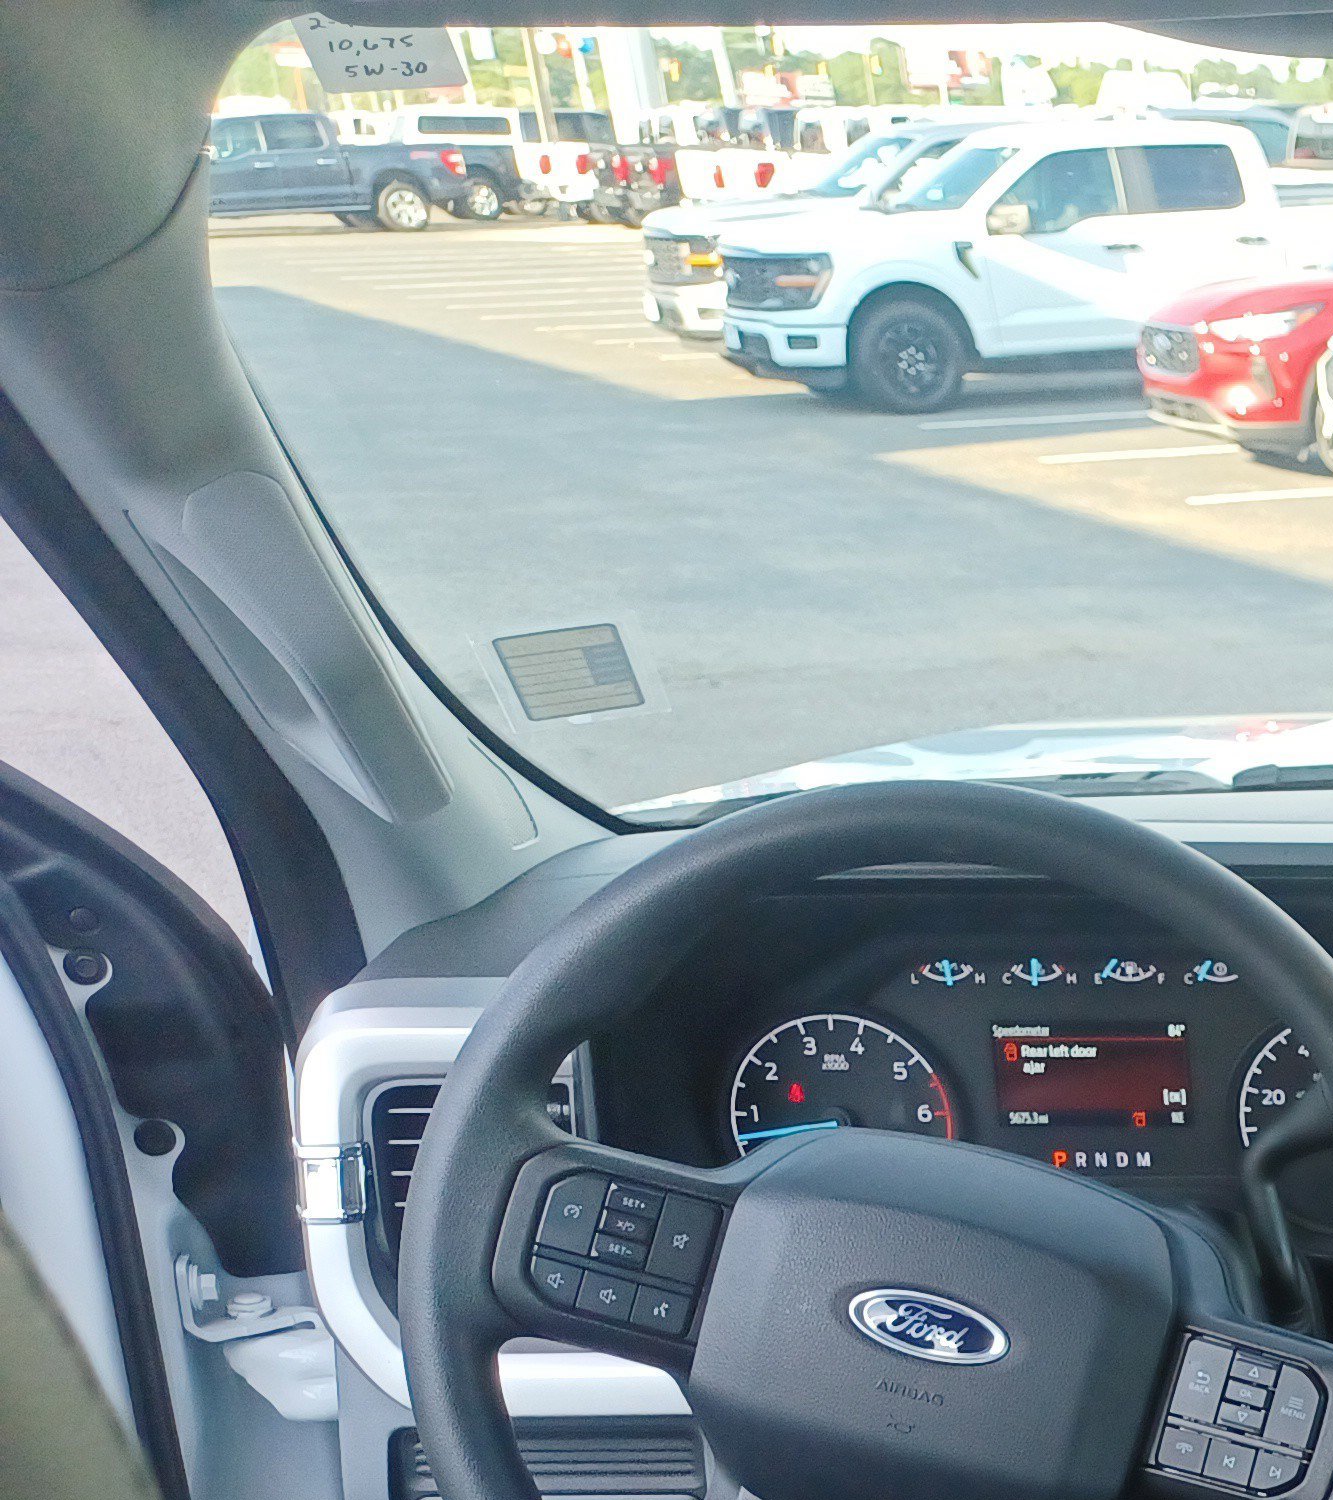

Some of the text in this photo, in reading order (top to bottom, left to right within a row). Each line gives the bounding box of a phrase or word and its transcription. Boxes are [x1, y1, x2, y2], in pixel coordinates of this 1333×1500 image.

[328, 34, 413, 56] 10,675
[345, 61, 428, 78] 5W-30
[802, 1036, 817, 1056] 3
[849, 1036, 865, 1055] 4
[1020, 1044, 1047, 1057] Rear
[1071, 1044, 1098, 1058] door
[764, 1061, 779, 1081] 2
[892, 1061, 908, 1081] 5
[1261, 1088, 1287, 1106] 20
[750, 1104, 760, 1123] 1
[917, 1104, 933, 1123] 6
[1053, 1150, 1151, 1168] P R N D M
[885, 1303, 970, 1350] Ford
[1280, 1406, 1307, 1421] MENU
